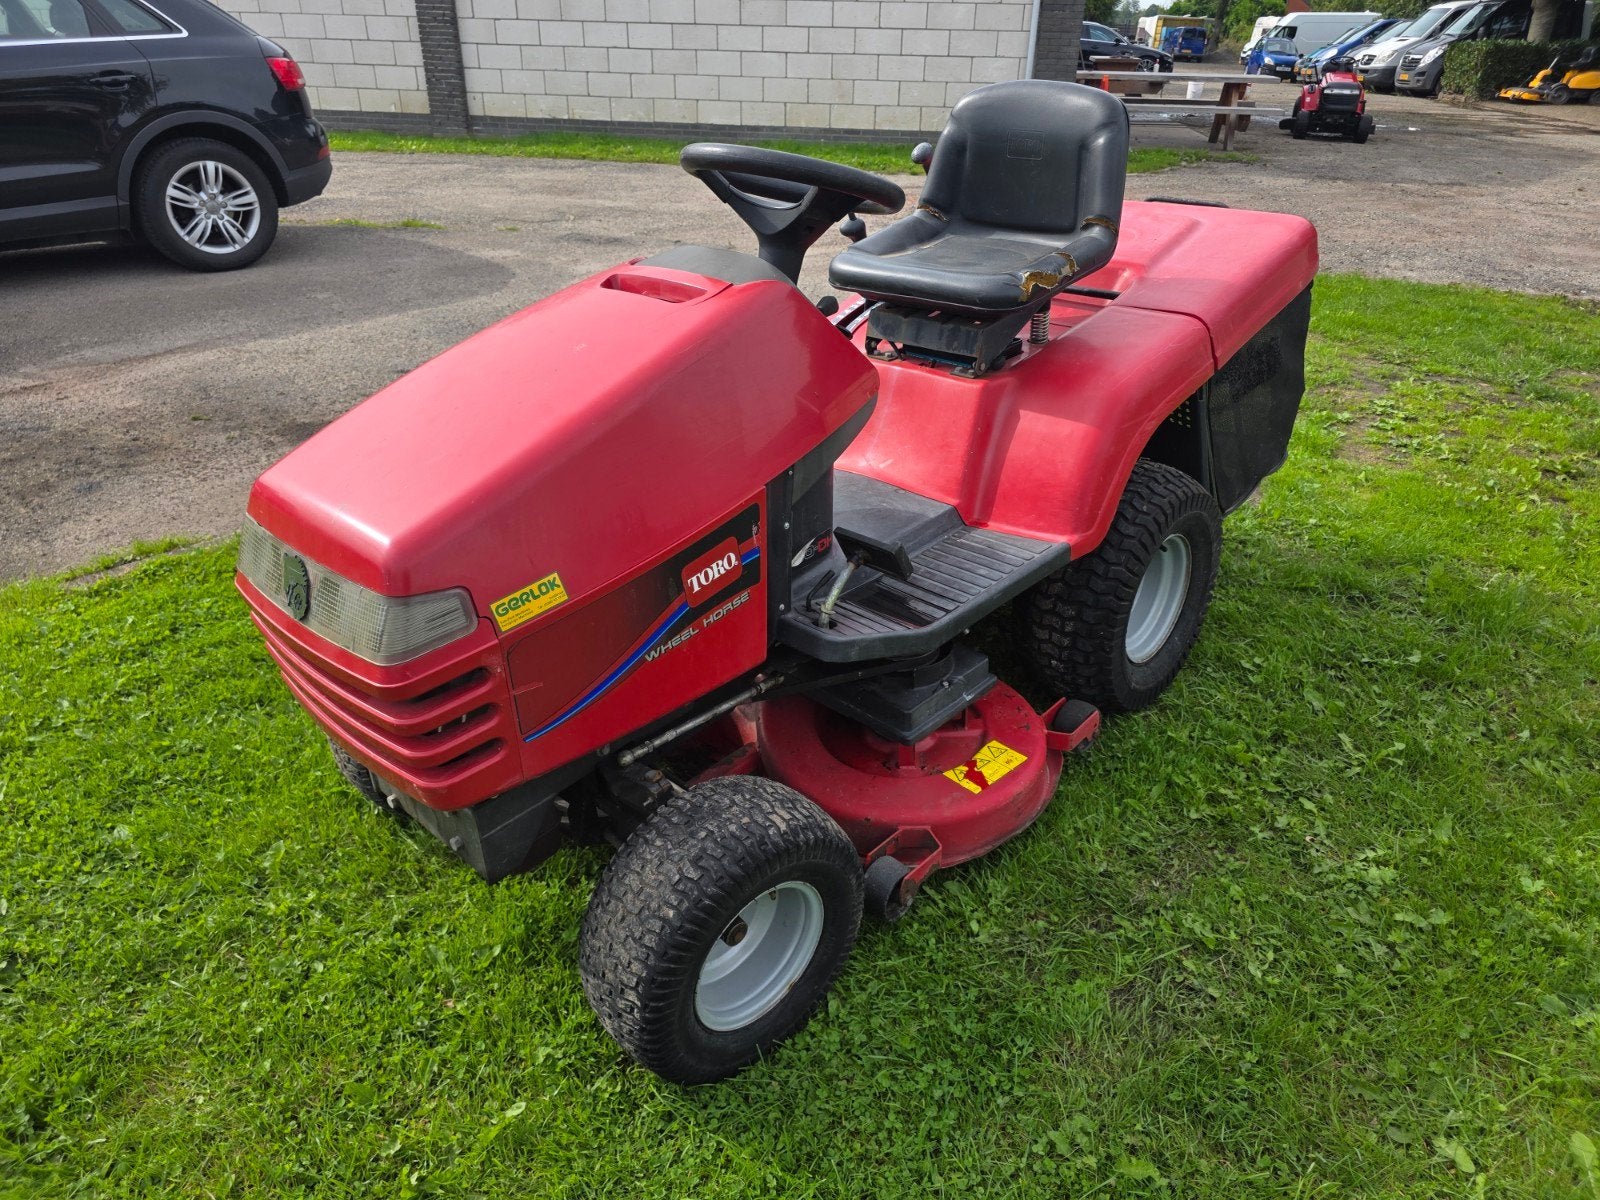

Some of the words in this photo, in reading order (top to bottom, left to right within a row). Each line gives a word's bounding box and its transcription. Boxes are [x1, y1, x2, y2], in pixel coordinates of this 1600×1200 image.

[687, 552, 738, 594] TORO
[494, 576, 561, 618] GERLOK
[644, 627, 699, 662] WHEEL
[702, 590, 750, 628] HORSE
